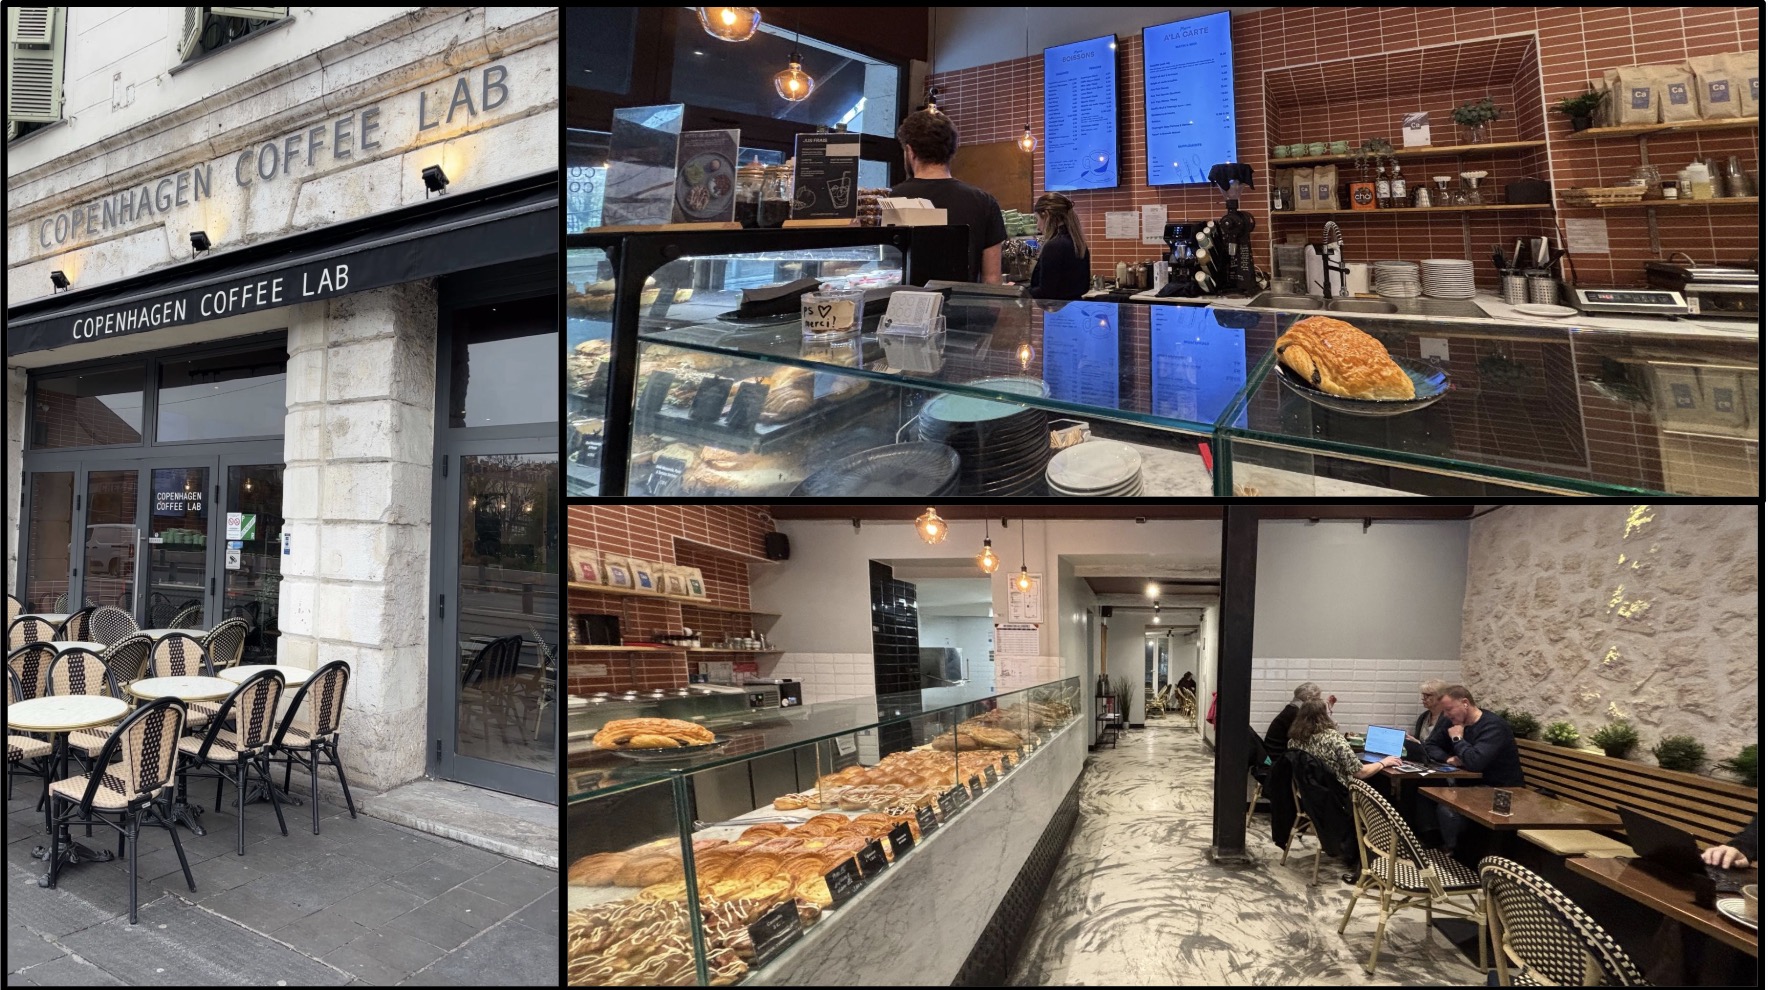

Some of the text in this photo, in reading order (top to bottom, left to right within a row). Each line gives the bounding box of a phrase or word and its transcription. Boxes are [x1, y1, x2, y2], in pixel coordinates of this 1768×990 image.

[1182, 26, 1209, 38] CARTE
[1062, 50, 1095, 63] BOISSONS
[1671, 86, 1683, 94] Ca
[1712, 83, 1725, 91] Ca
[40, 65, 510, 249] COPENHAGEN COFFEE LAB
[73, 264, 350, 340] COPENHAGEN COFFEE LAB
[156, 491, 202, 501] COPENHAGEN
[156, 502, 202, 511] COFFEE LAB
